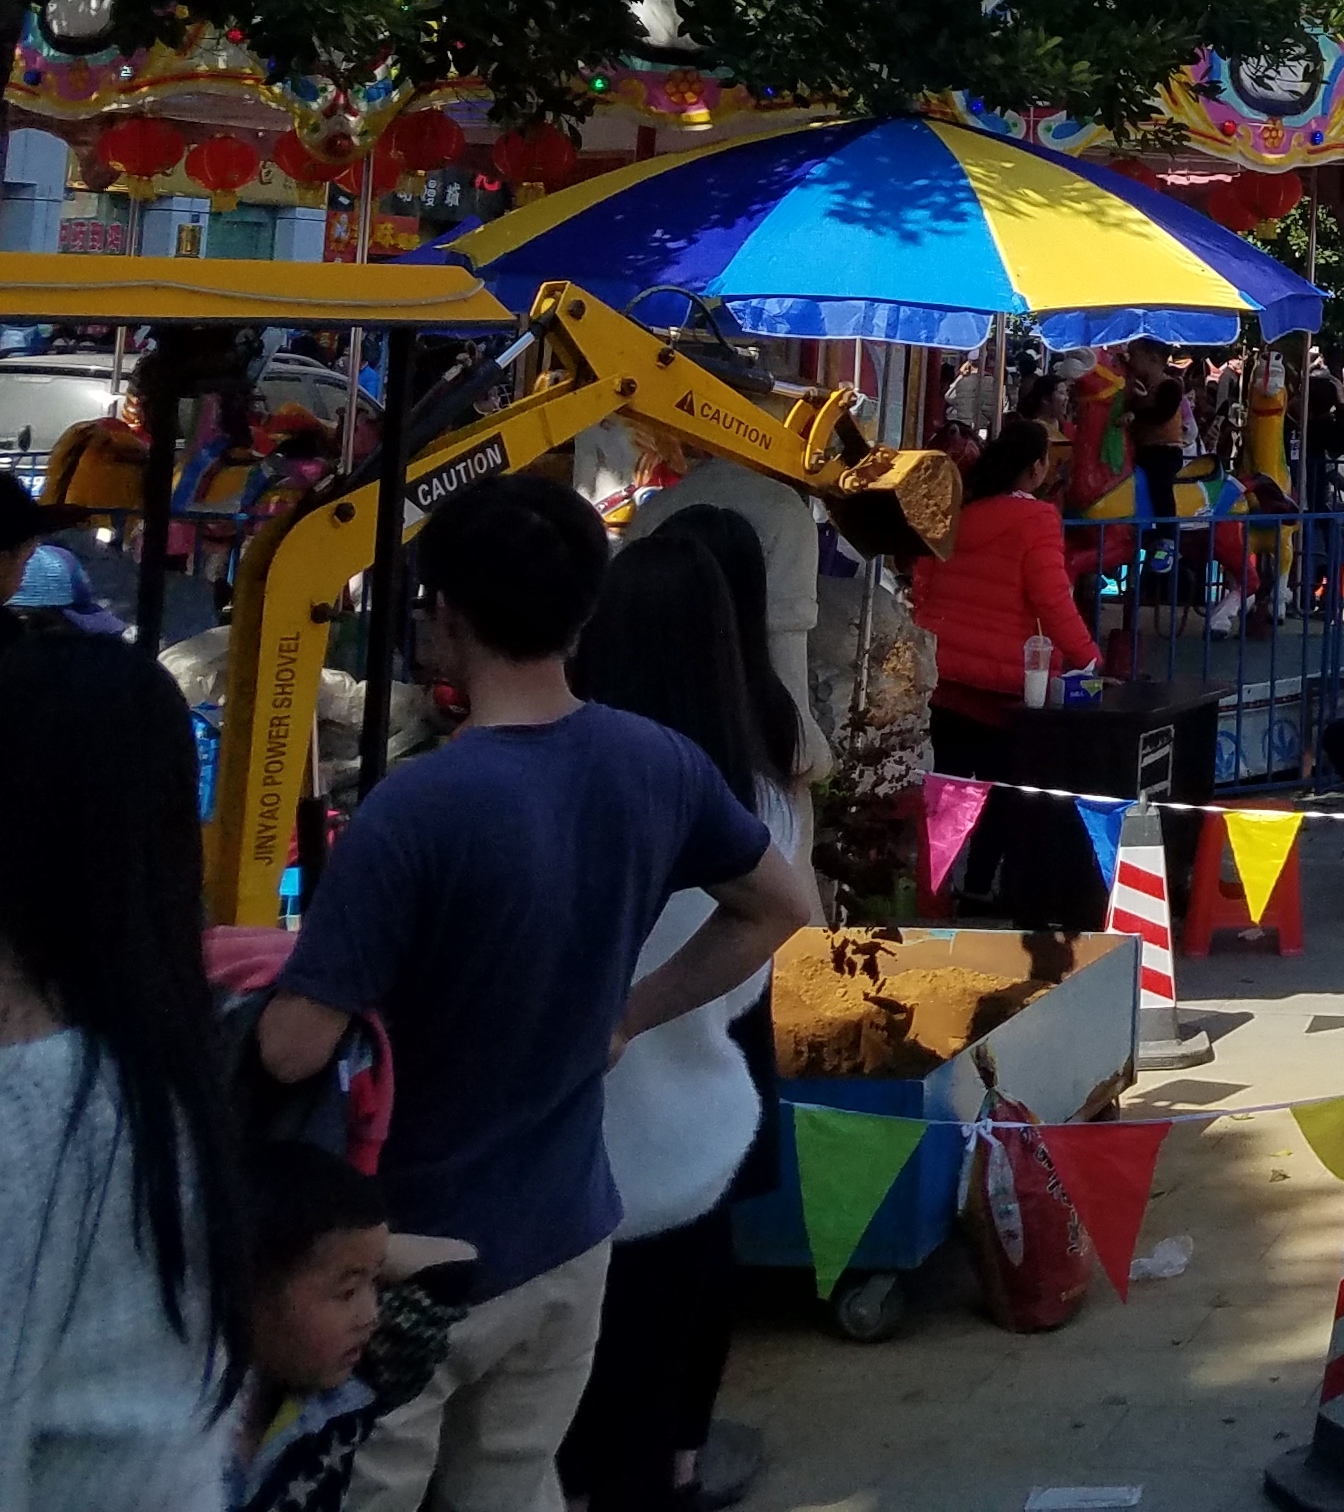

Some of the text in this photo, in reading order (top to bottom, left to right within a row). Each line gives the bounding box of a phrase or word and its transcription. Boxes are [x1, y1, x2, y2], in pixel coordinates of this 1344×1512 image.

[700, 401, 773, 451] CAUTION
[417, 442, 503, 506] CAUTION
[254, 631, 300, 867] JINYAO POWER SHOVEL
